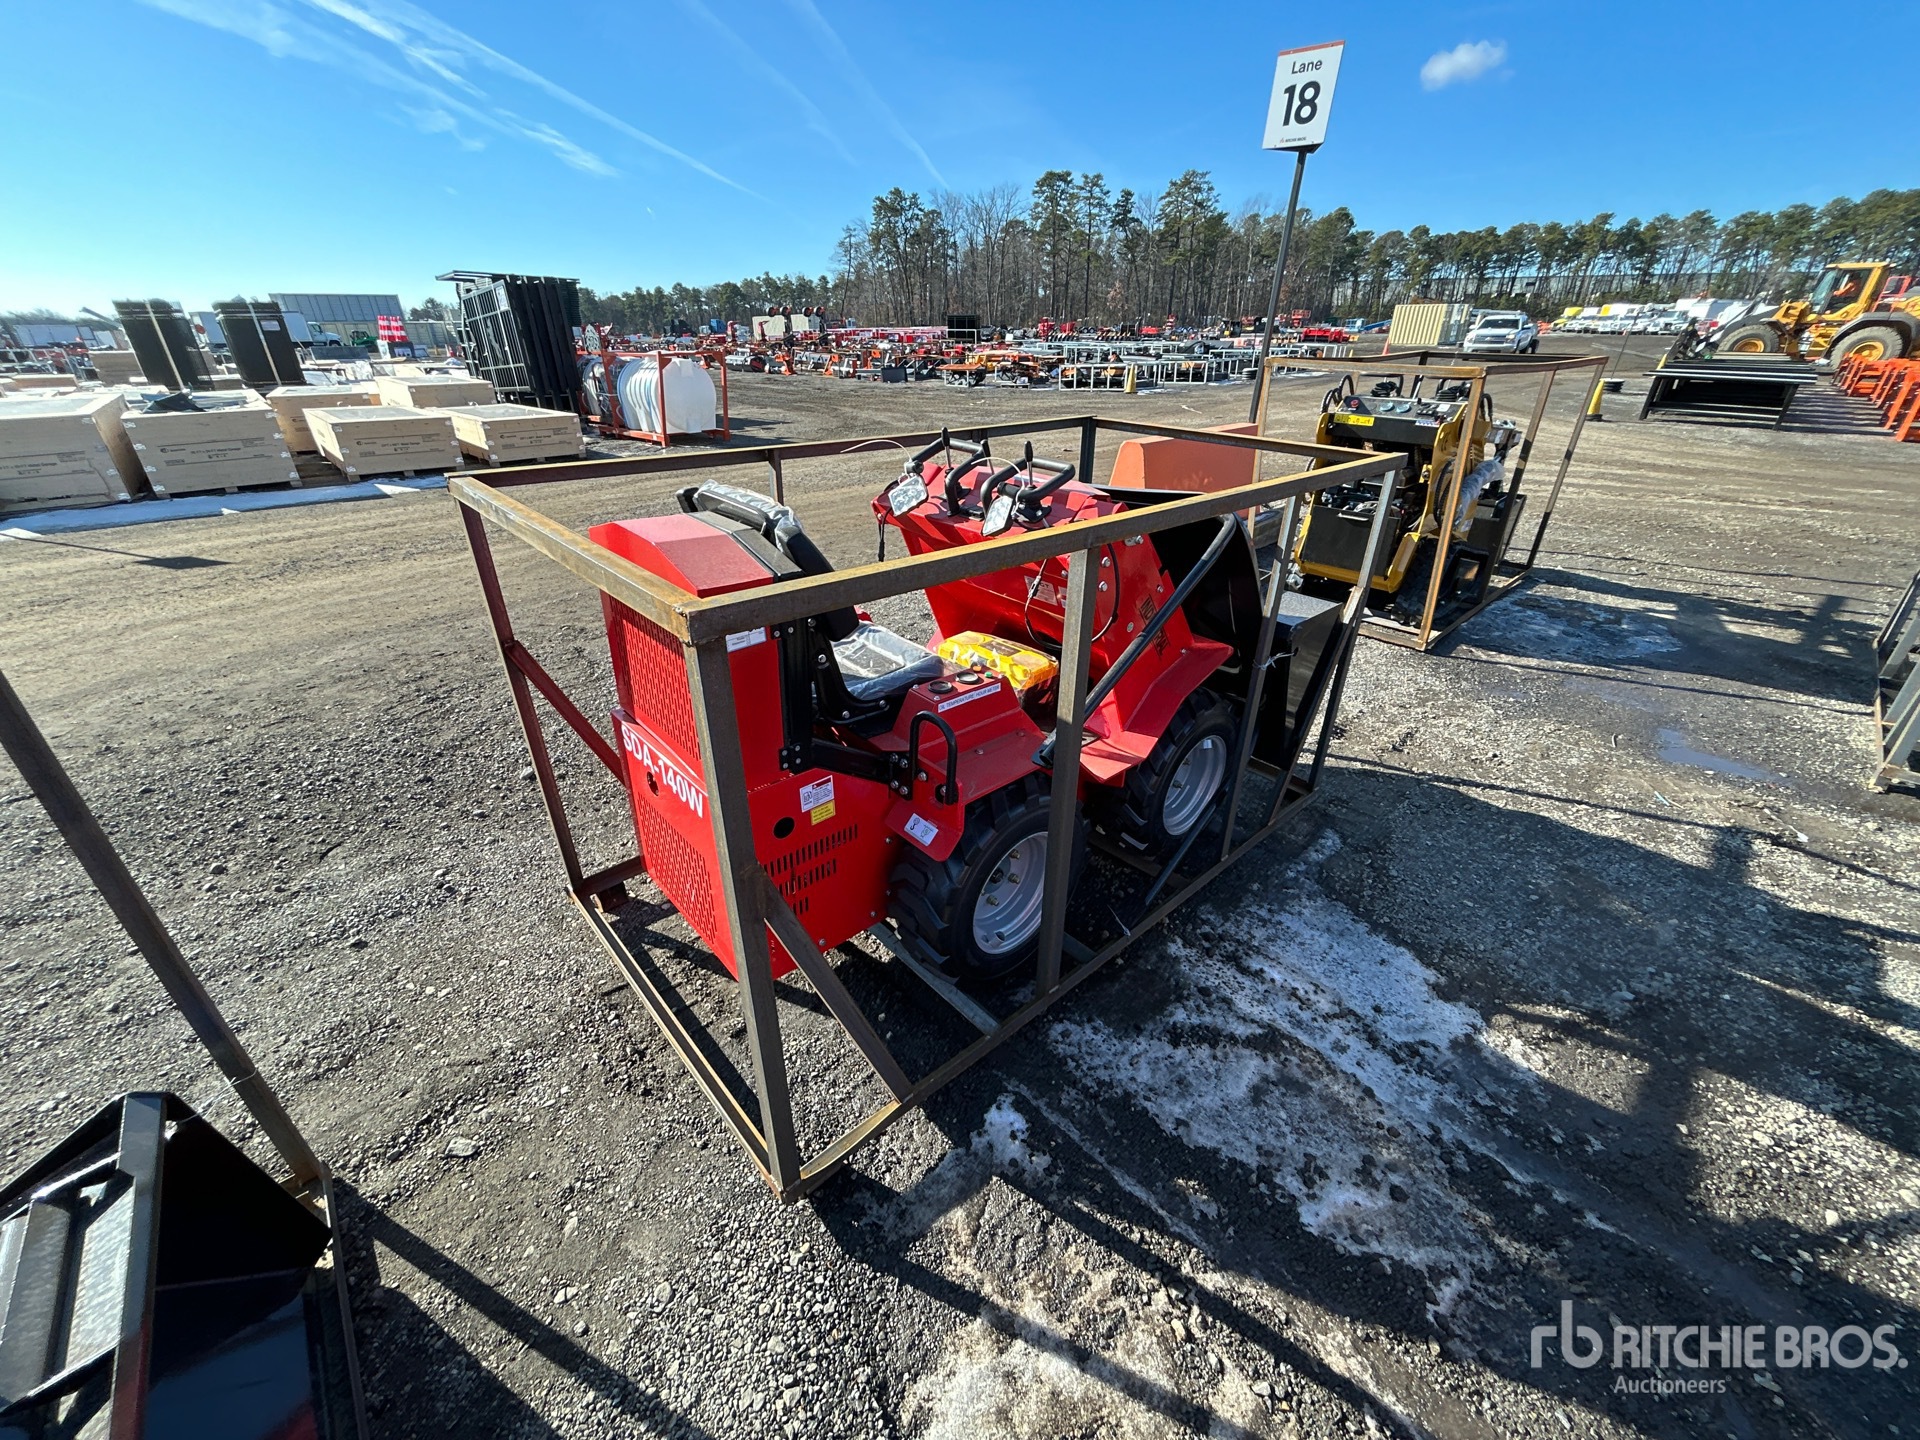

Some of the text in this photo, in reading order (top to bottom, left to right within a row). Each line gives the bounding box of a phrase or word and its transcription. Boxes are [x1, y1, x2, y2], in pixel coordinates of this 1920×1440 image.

[1291, 59, 1323, 75] Lane
[1282, 80, 1321, 127] 18
[1140, 596, 1169, 656] INDRIAL
[621, 724, 703, 819] SDA-140W
